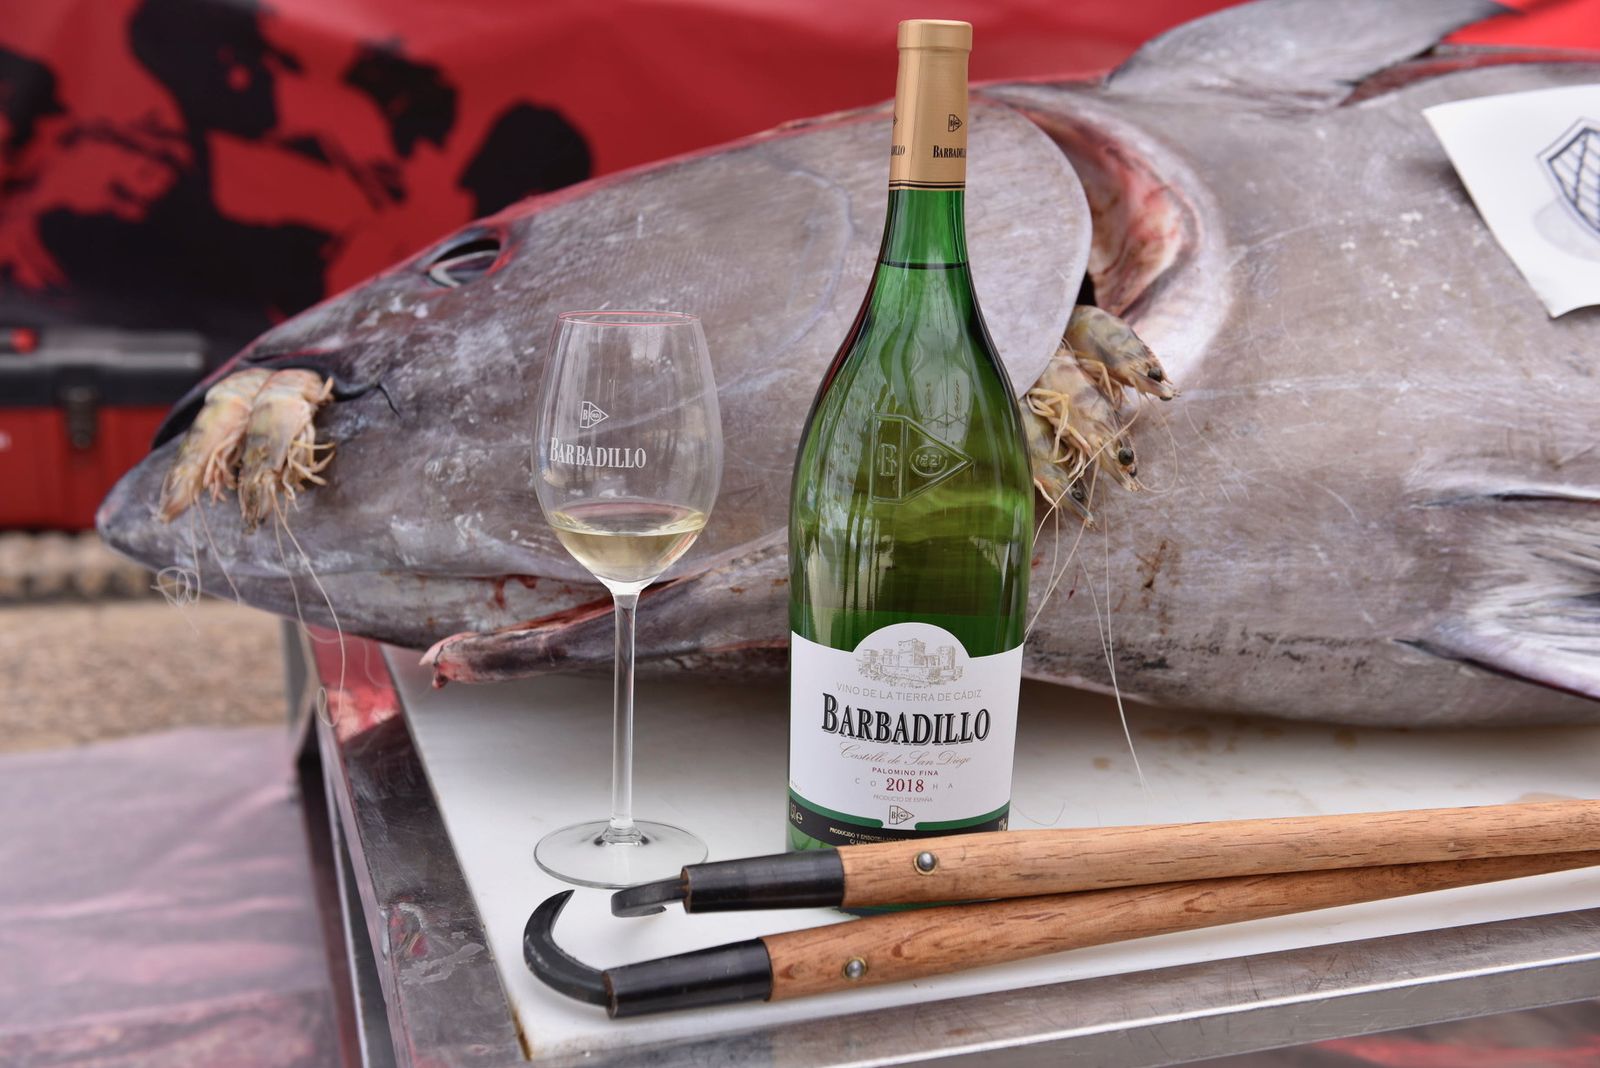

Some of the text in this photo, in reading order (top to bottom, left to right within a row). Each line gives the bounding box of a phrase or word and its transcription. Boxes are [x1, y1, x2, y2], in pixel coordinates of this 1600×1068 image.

[550, 437, 647, 468] BARBADILLO
[836, 682, 860, 695] VINO
[862, 688, 878, 698] DE
[879, 690, 894, 700] LA
[896, 692, 935, 702] TIERRA
[937, 692, 951, 702] DE
[822, 693, 991, 746] BARBADILLO
[840, 741, 889, 762] Castillo
[887, 754, 903, 765] de
[904, 750, 934, 766] San
[872, 767, 916, 776] PALOMINO
[886, 777, 924, 793] 2018
[873, 793, 905, 802] PRODUCTO
